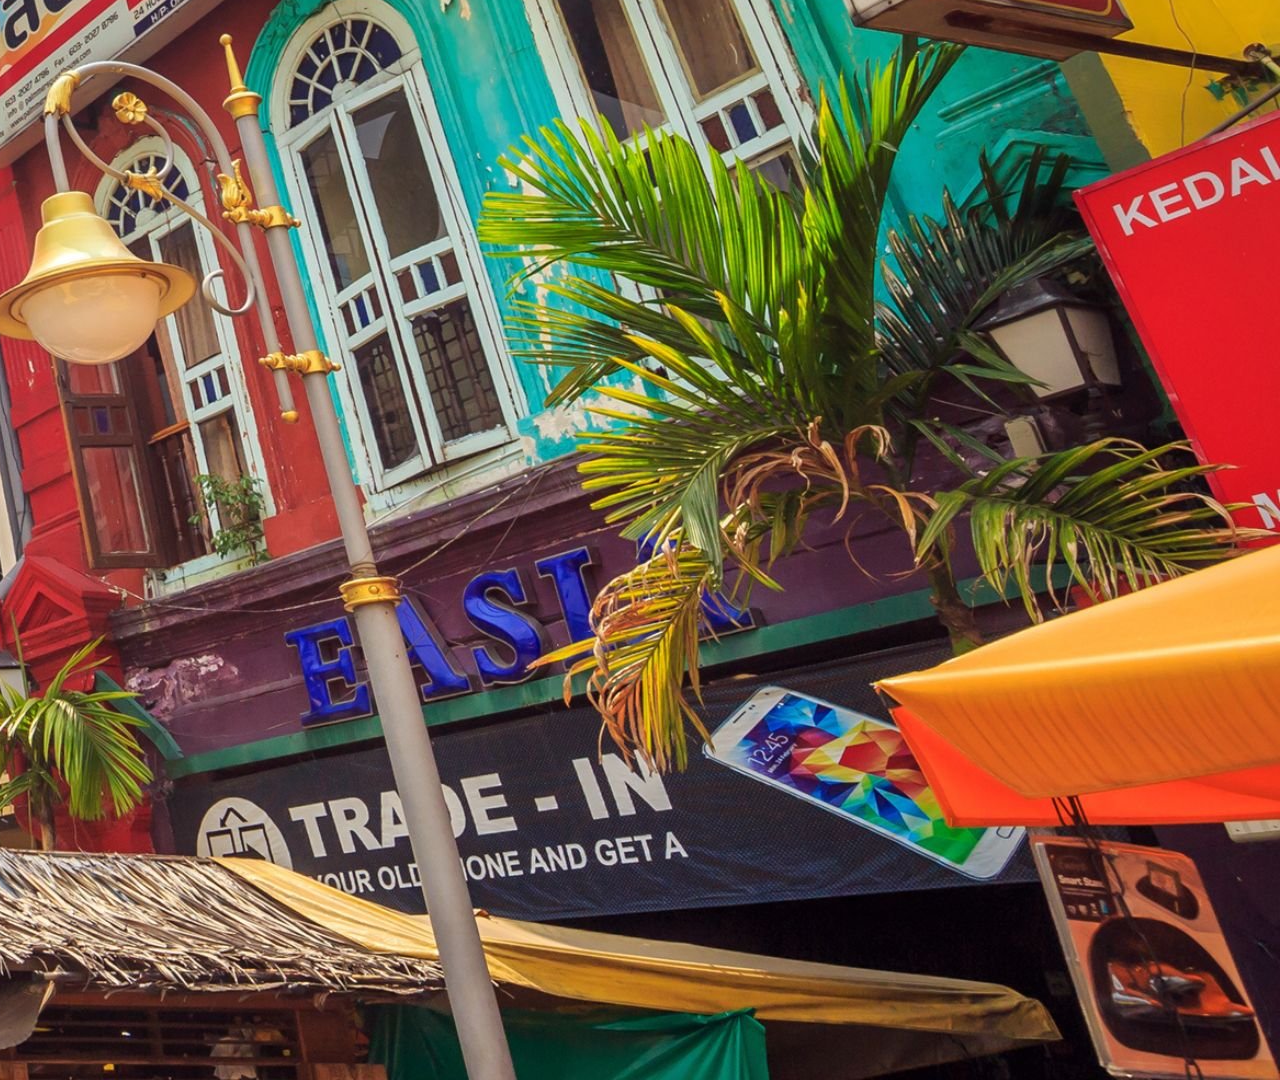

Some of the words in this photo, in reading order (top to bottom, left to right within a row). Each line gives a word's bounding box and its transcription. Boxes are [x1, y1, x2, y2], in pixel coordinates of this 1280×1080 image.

[133, 8, 146, 21] 24
[748, 732, 789, 766] 12:45
[572, 750, 674, 820] IN
[529, 843, 587, 876] AND
[594, 834, 653, 869] GET
[664, 831, 690, 862] A
[1057, 874, 1083, 886] Smart
